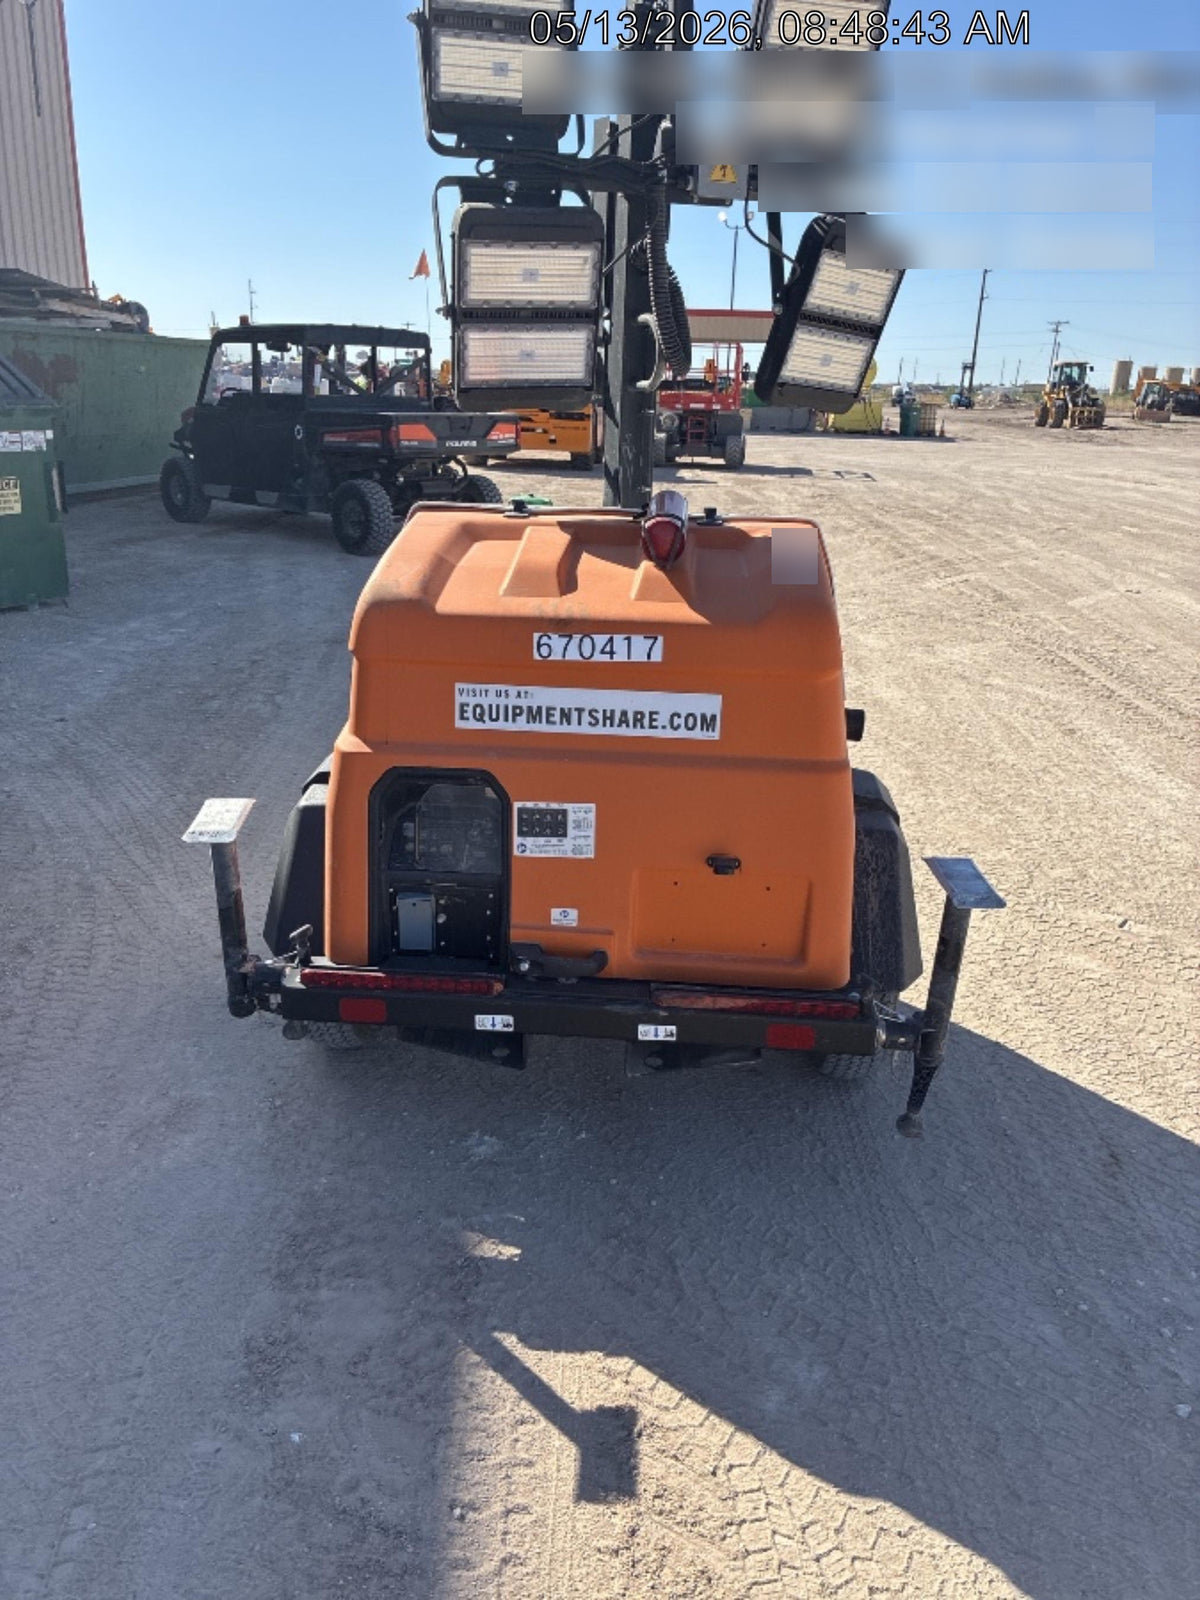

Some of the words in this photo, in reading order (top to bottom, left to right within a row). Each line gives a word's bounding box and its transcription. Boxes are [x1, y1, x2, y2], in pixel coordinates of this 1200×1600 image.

[535, 633, 659, 661] 670417
[457, 687, 490, 699] VISIT
[495, 688, 510, 700] US
[459, 702, 717, 732] EQUIPMENTSHARE.COM
